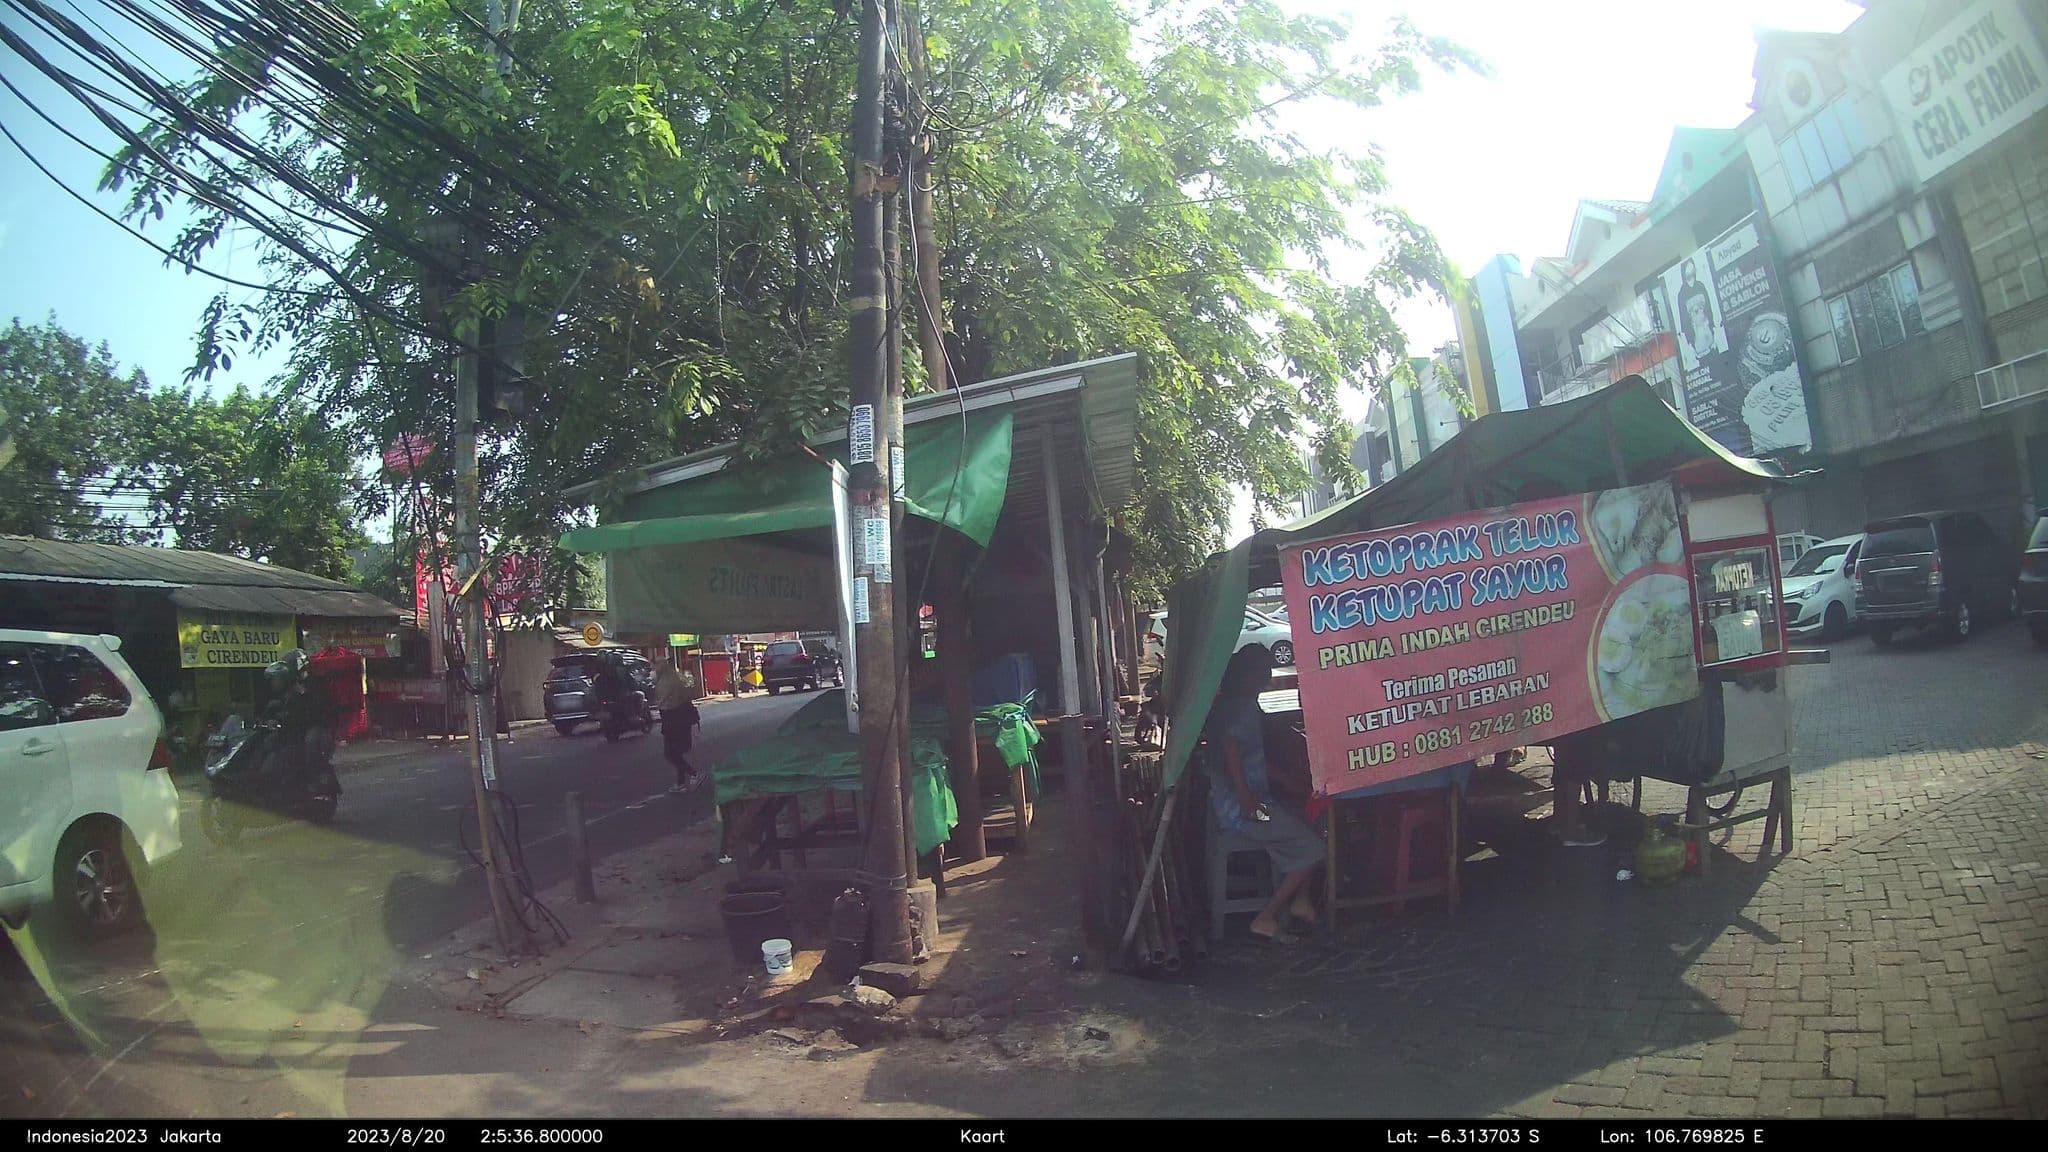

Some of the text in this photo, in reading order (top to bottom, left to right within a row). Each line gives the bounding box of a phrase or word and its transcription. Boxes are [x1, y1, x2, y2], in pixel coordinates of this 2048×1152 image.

[1934, 10, 2006, 85] APOTIK
[1912, 44, 2042, 160] CERA FARMA
[1718, 267, 1742, 288] JASA
[1720, 265, 1766, 300] KONVEKSI
[1730, 279, 1770, 308] SABLON
[1302, 510, 1580, 587] KETOPRAK TELUR
[1310, 554, 1570, 634] KETUPAT SAYUR
[201, 629, 280, 646] GAYA BARU
[207, 649, 278, 665] CIRENDEU
[1318, 600, 1576, 670] PRIMA INDAH CIRENDEU
[1347, 672, 1550, 735] KETUPAT LEBARAN
[1382, 657, 1517, 701] Terima Pesanan
[1348, 741, 1397, 770] HUB
[1415, 727, 1462, 755] 0881
[1469, 713, 1515, 742] 2742
[1521, 702, 1554, 728] 288
